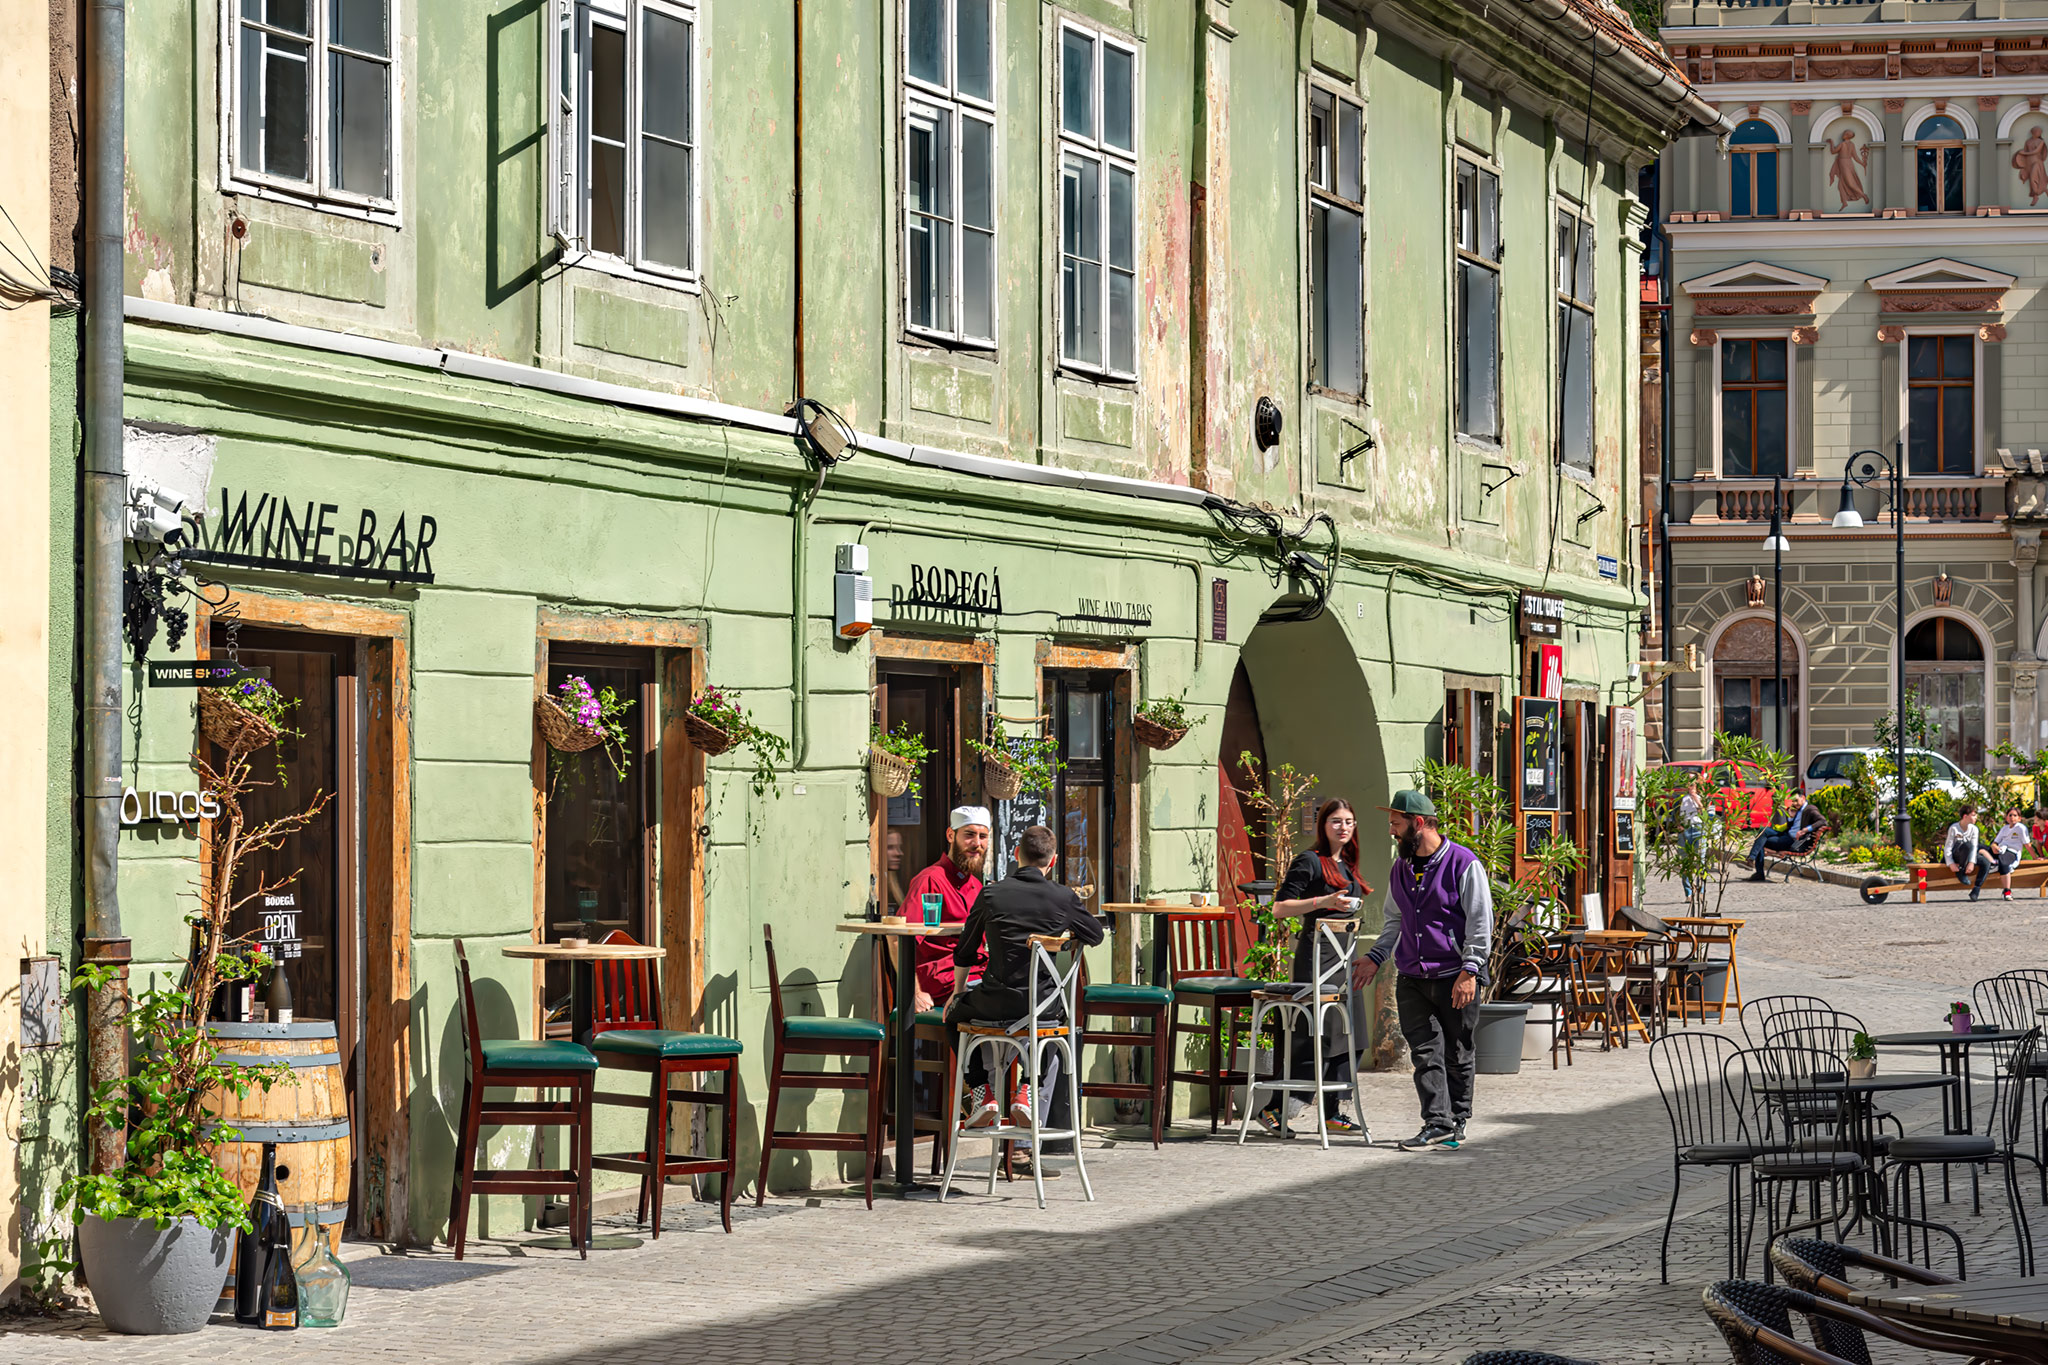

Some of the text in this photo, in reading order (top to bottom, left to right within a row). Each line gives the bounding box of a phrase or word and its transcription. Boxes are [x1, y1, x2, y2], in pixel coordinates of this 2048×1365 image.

[221, 487, 437, 574] WINE BAR
[911, 563, 1002, 611] BODEGÁ
[1078, 598, 1152, 620] WINE AND TAPAS
[155, 668, 237, 679] WINE SHOP
[149, 790, 221, 824] IQOS
[264, 914, 296, 940] OPEN
